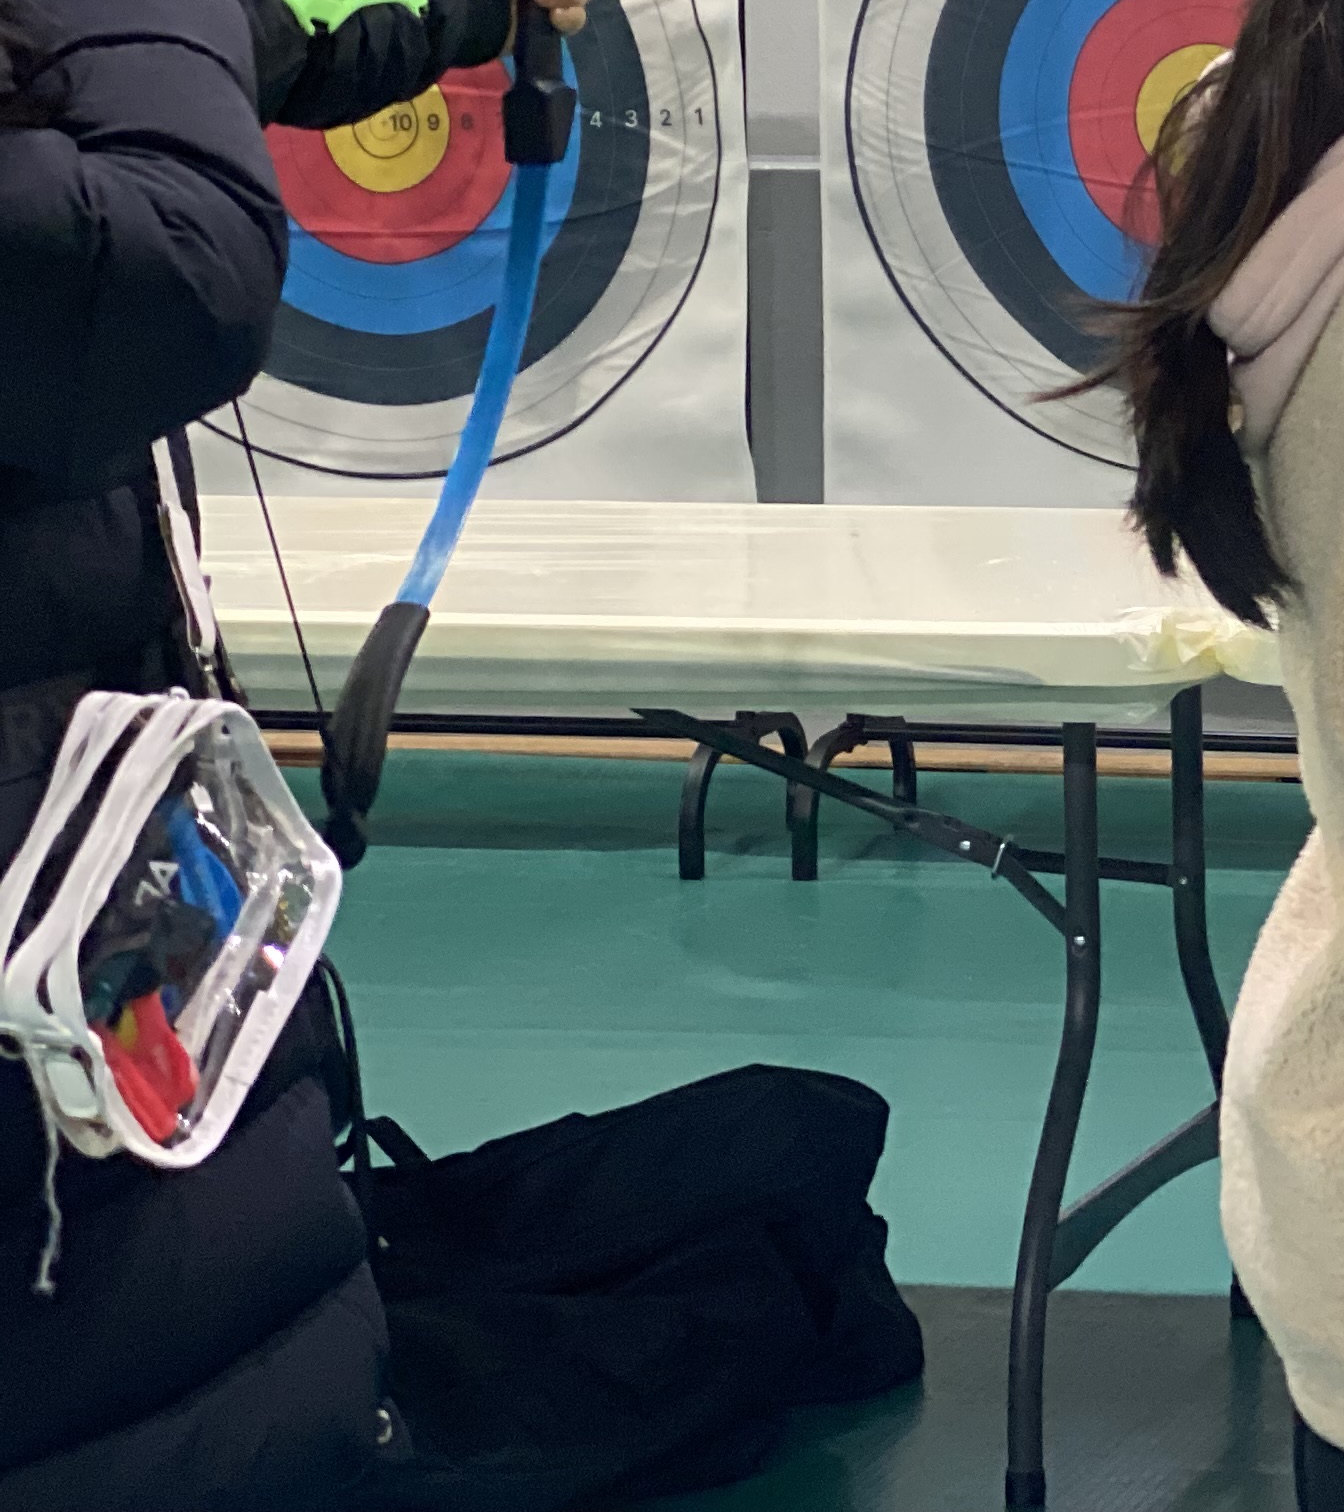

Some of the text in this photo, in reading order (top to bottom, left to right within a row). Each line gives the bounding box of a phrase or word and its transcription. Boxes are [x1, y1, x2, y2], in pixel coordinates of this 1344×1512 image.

[389, 114, 413, 132] 10
[427, 114, 440, 131] 9
[589, 110, 602, 129] 4
[624, 109, 639, 128] 3
[659, 108, 672, 127] 2
[694, 108, 704, 126] 1
